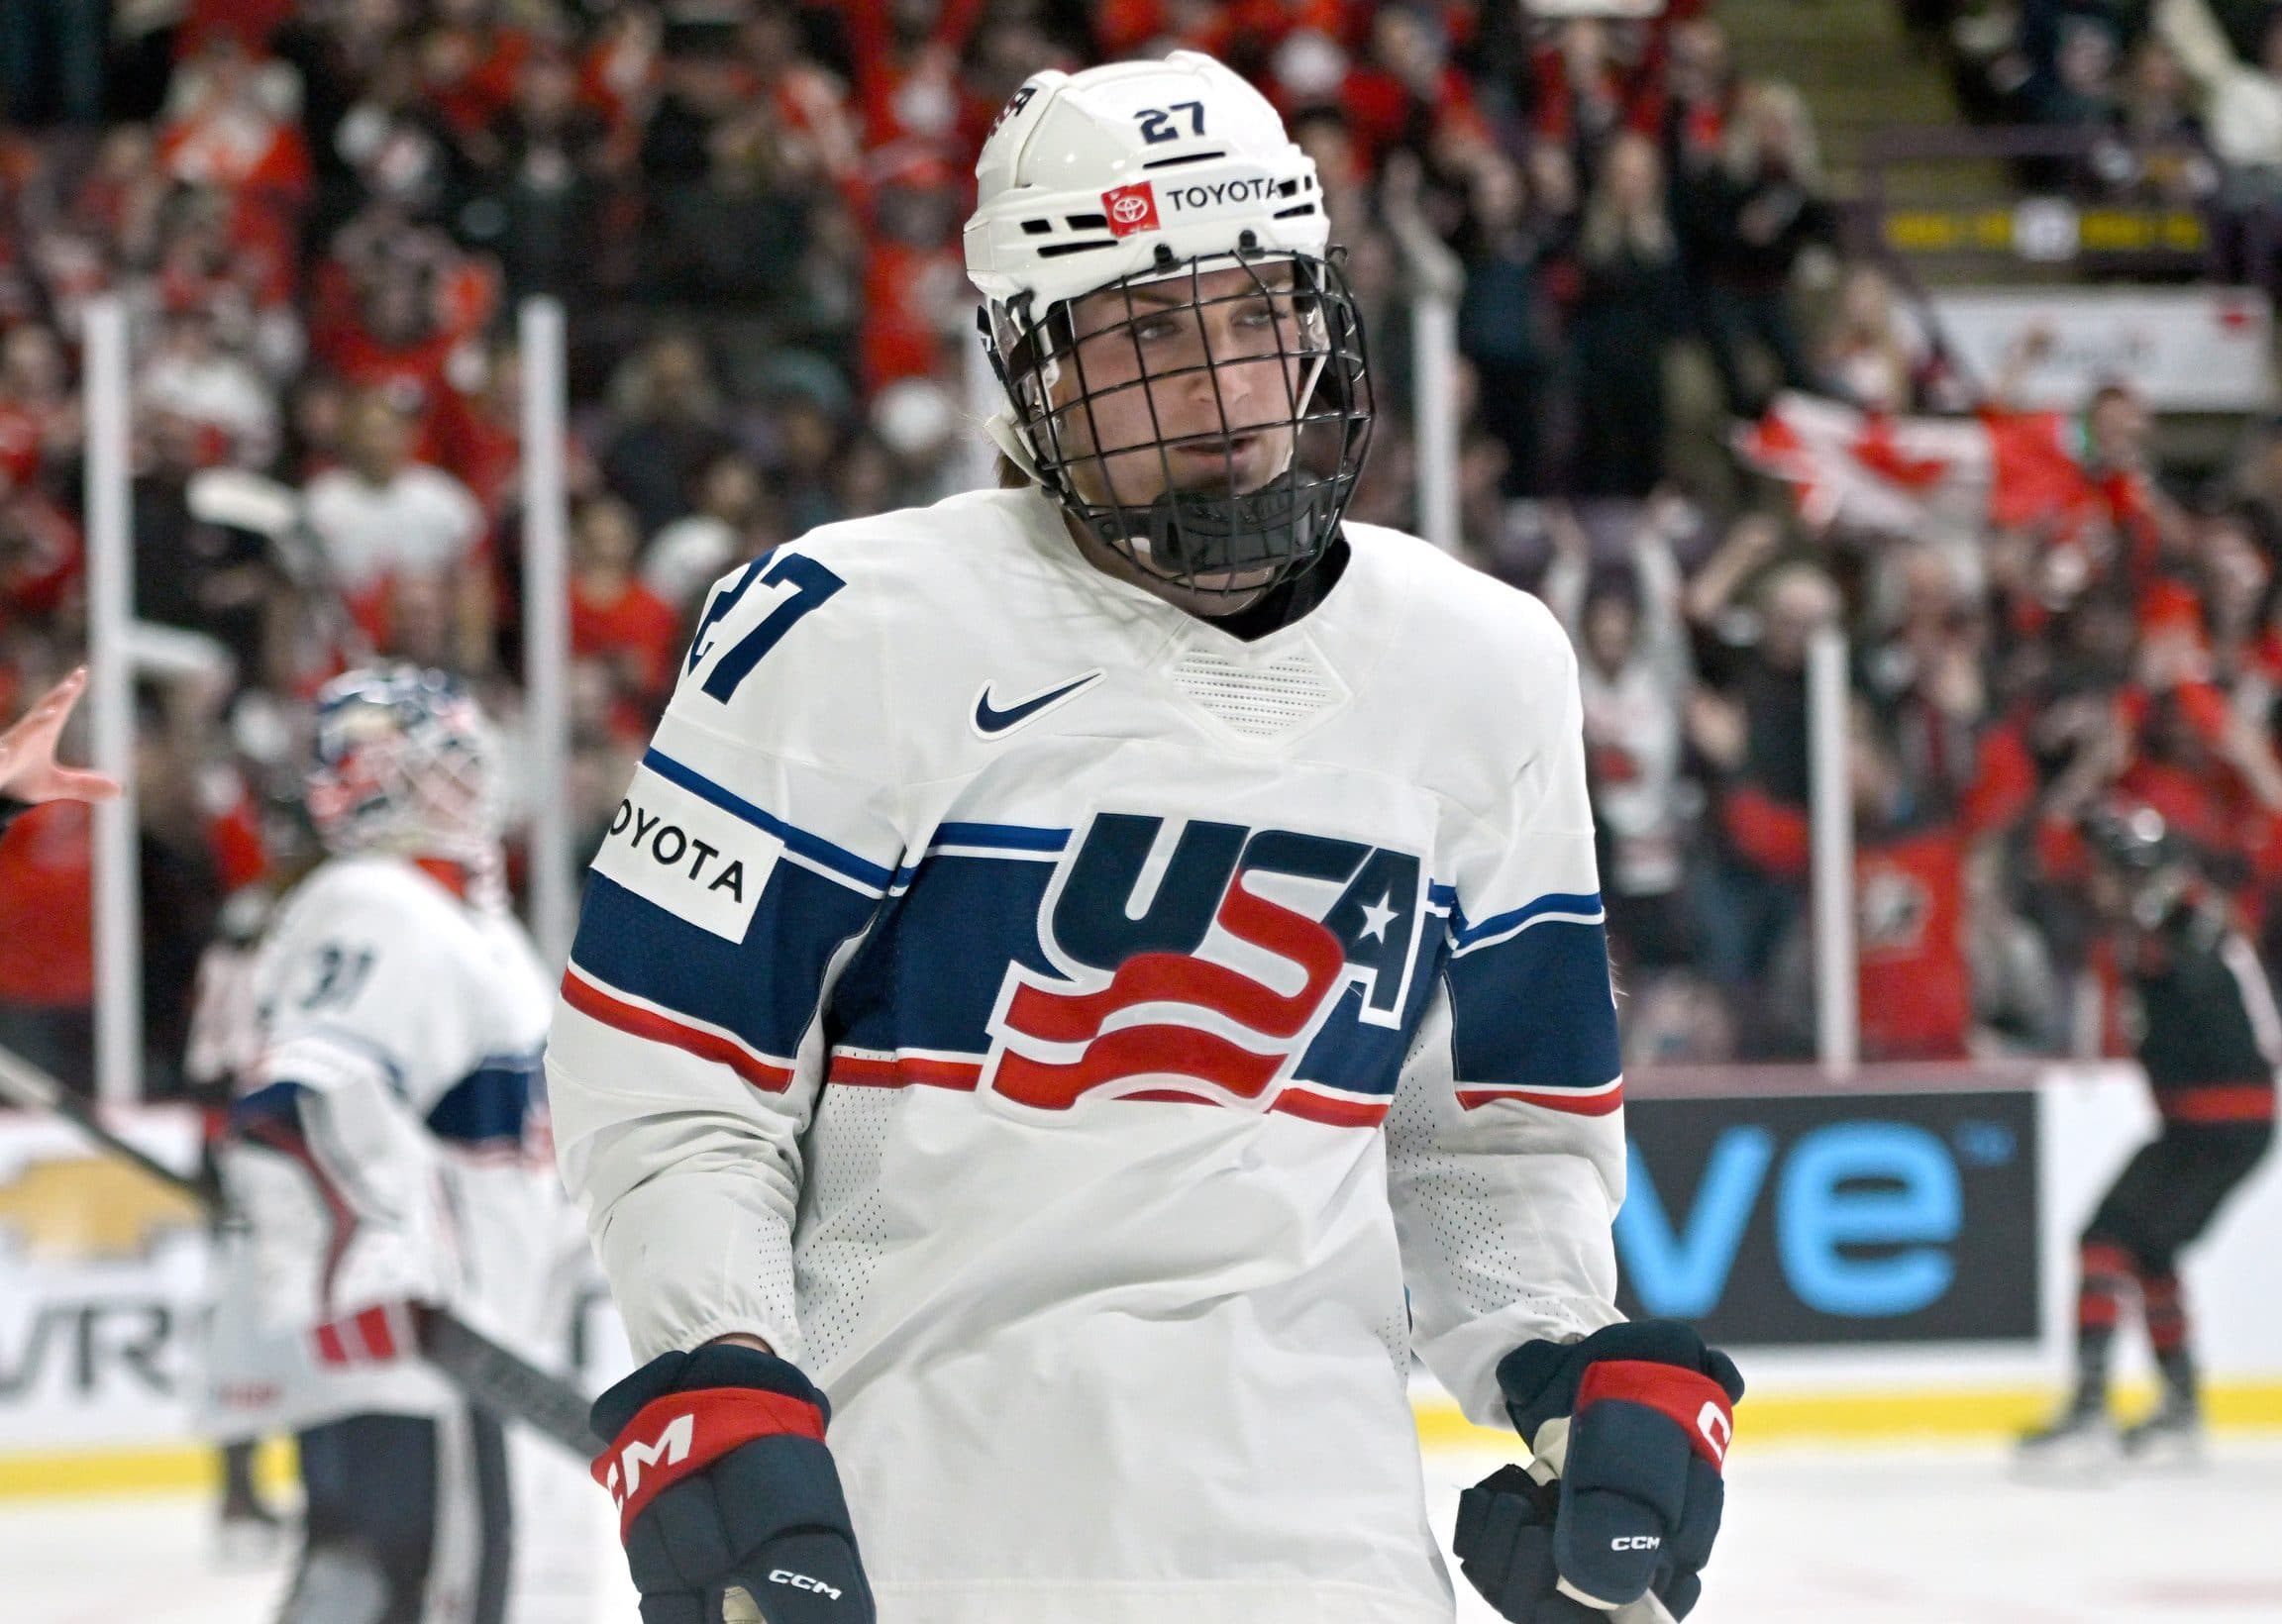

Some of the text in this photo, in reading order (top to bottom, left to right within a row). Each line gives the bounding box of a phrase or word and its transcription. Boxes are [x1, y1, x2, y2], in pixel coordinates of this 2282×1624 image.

[1133, 101, 1205, 146] 27
[1166, 178, 1278, 211] TOYOTA
[687, 546, 848, 706] 27
[1040, 812, 1422, 1050] USA
[1610, 1536, 1661, 1552] CCM
[769, 1569, 842, 1601] CCM
